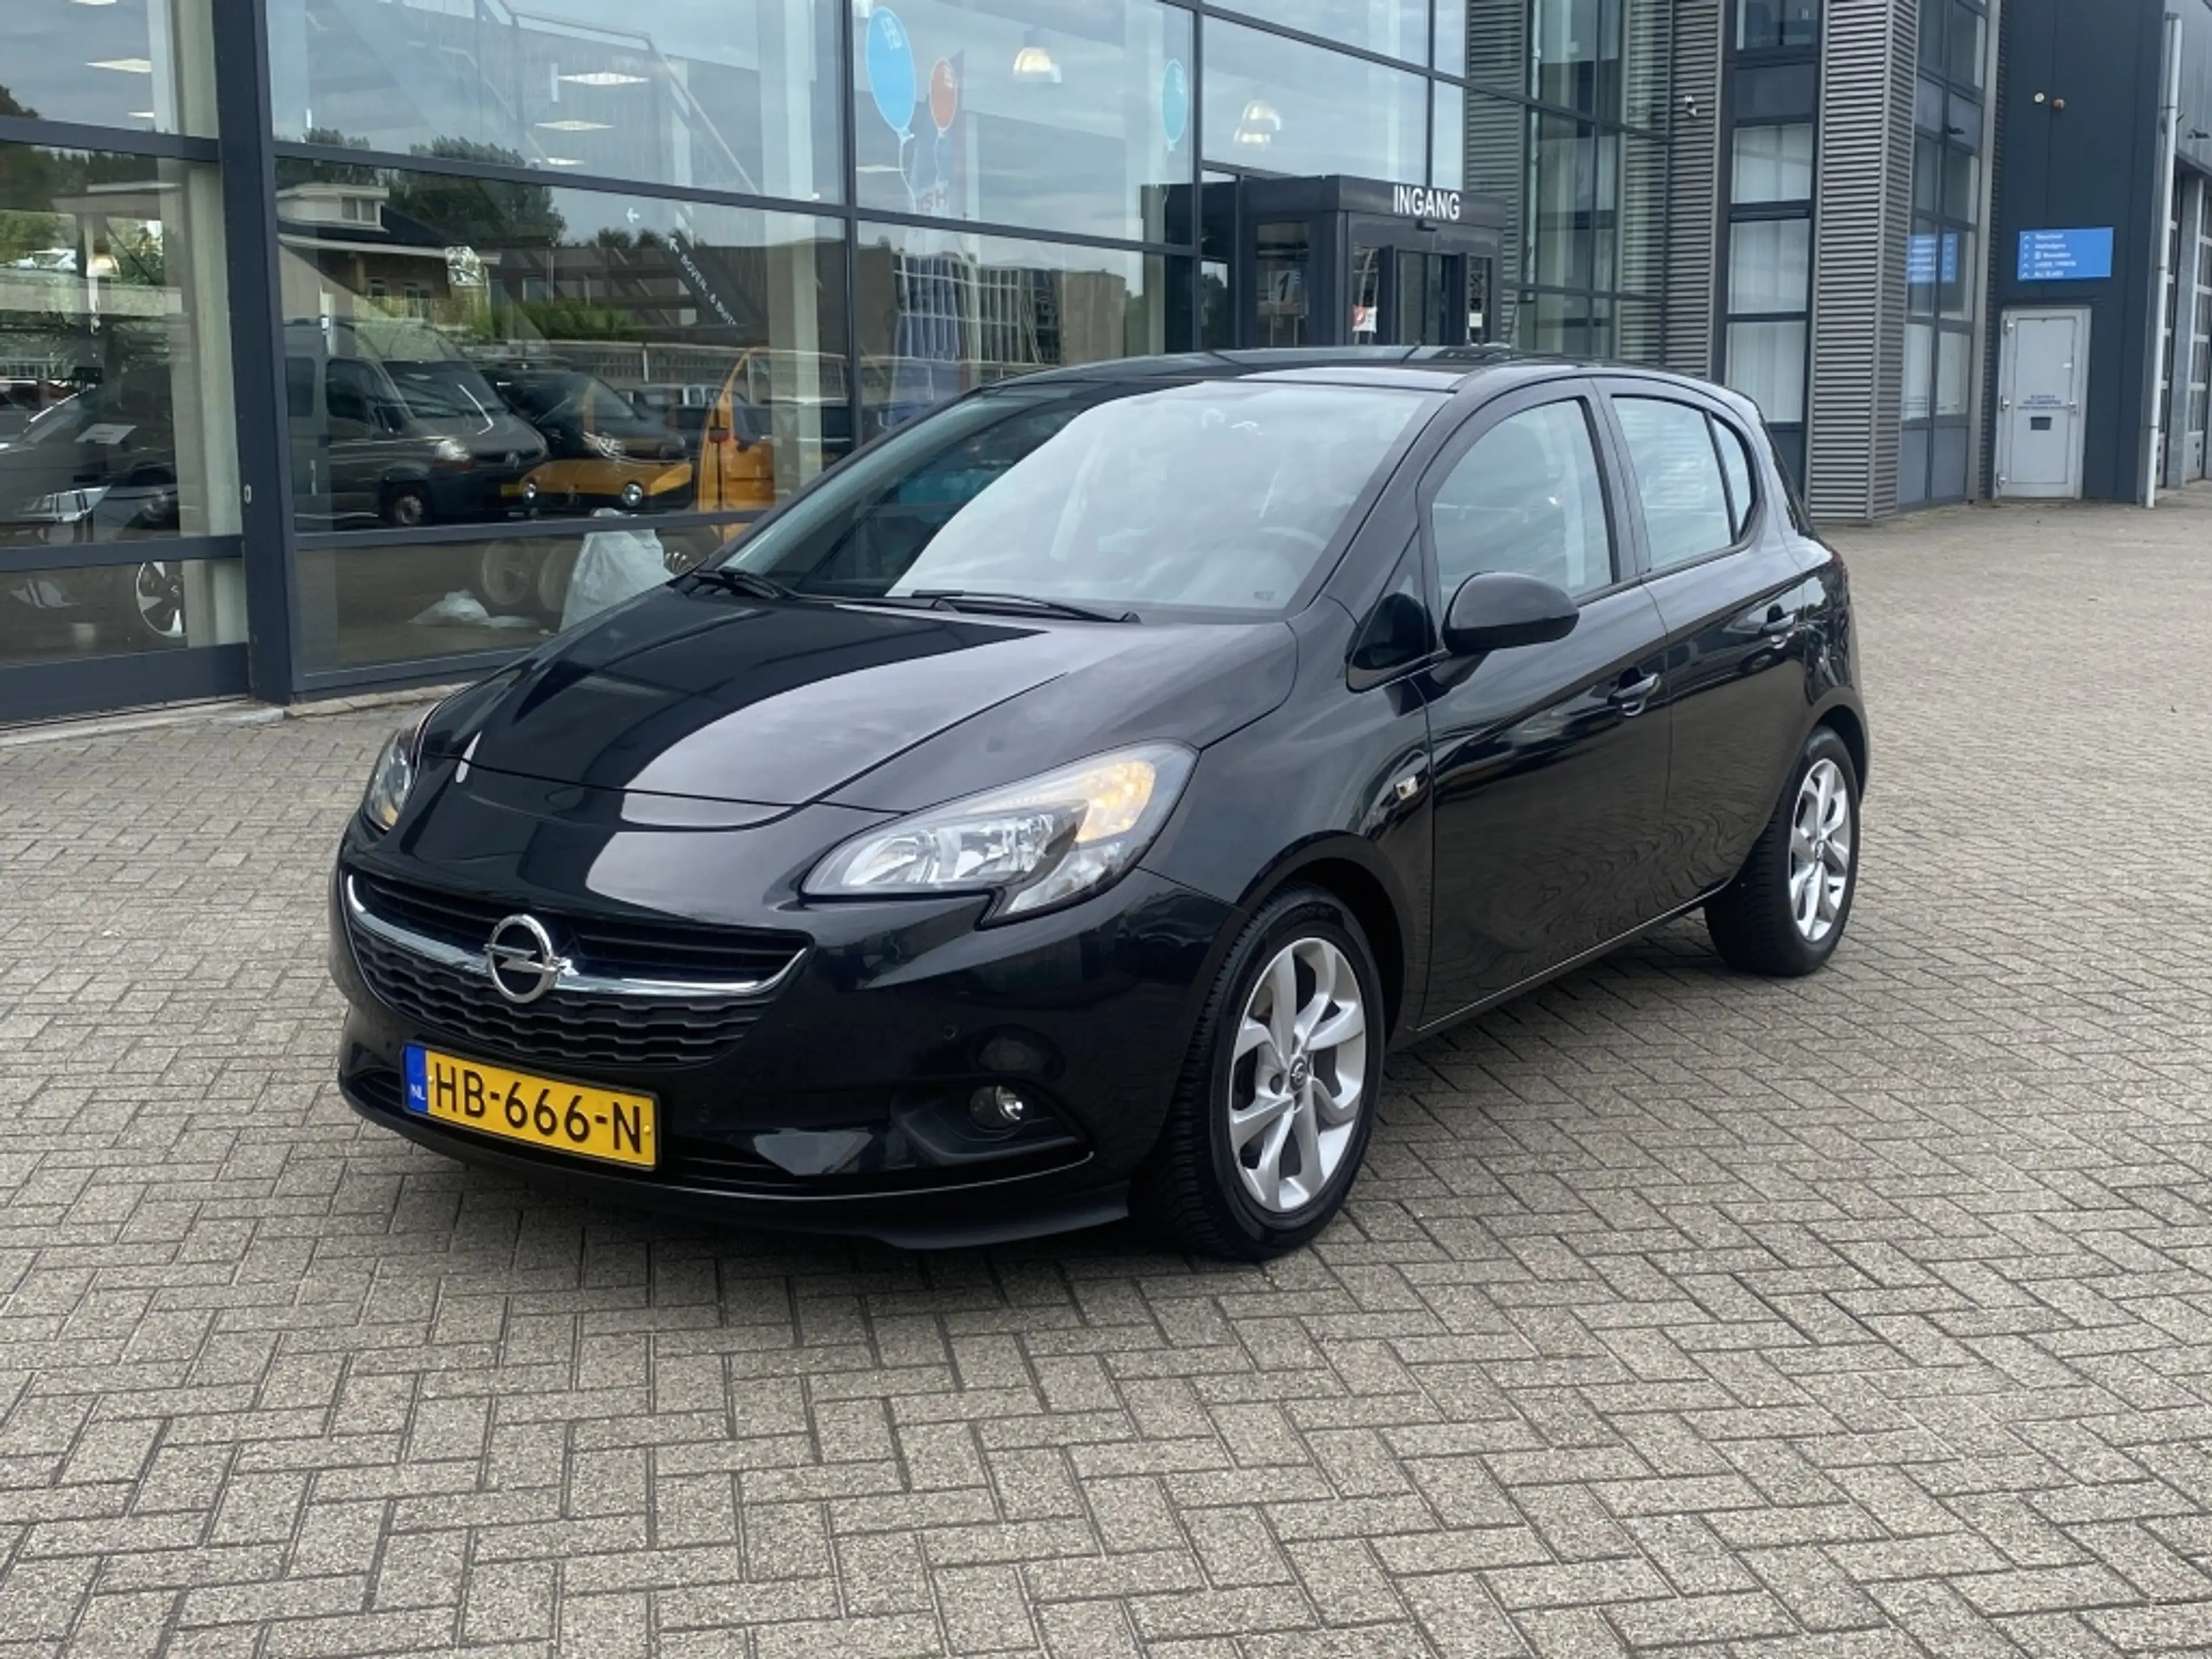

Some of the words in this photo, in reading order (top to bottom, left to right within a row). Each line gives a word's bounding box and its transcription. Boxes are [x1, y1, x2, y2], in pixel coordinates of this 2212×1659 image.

[1393, 185, 1460, 221] INGANG
[410, 1084, 426, 1100] NL
[435, 1062, 641, 1154] HB-666-N
